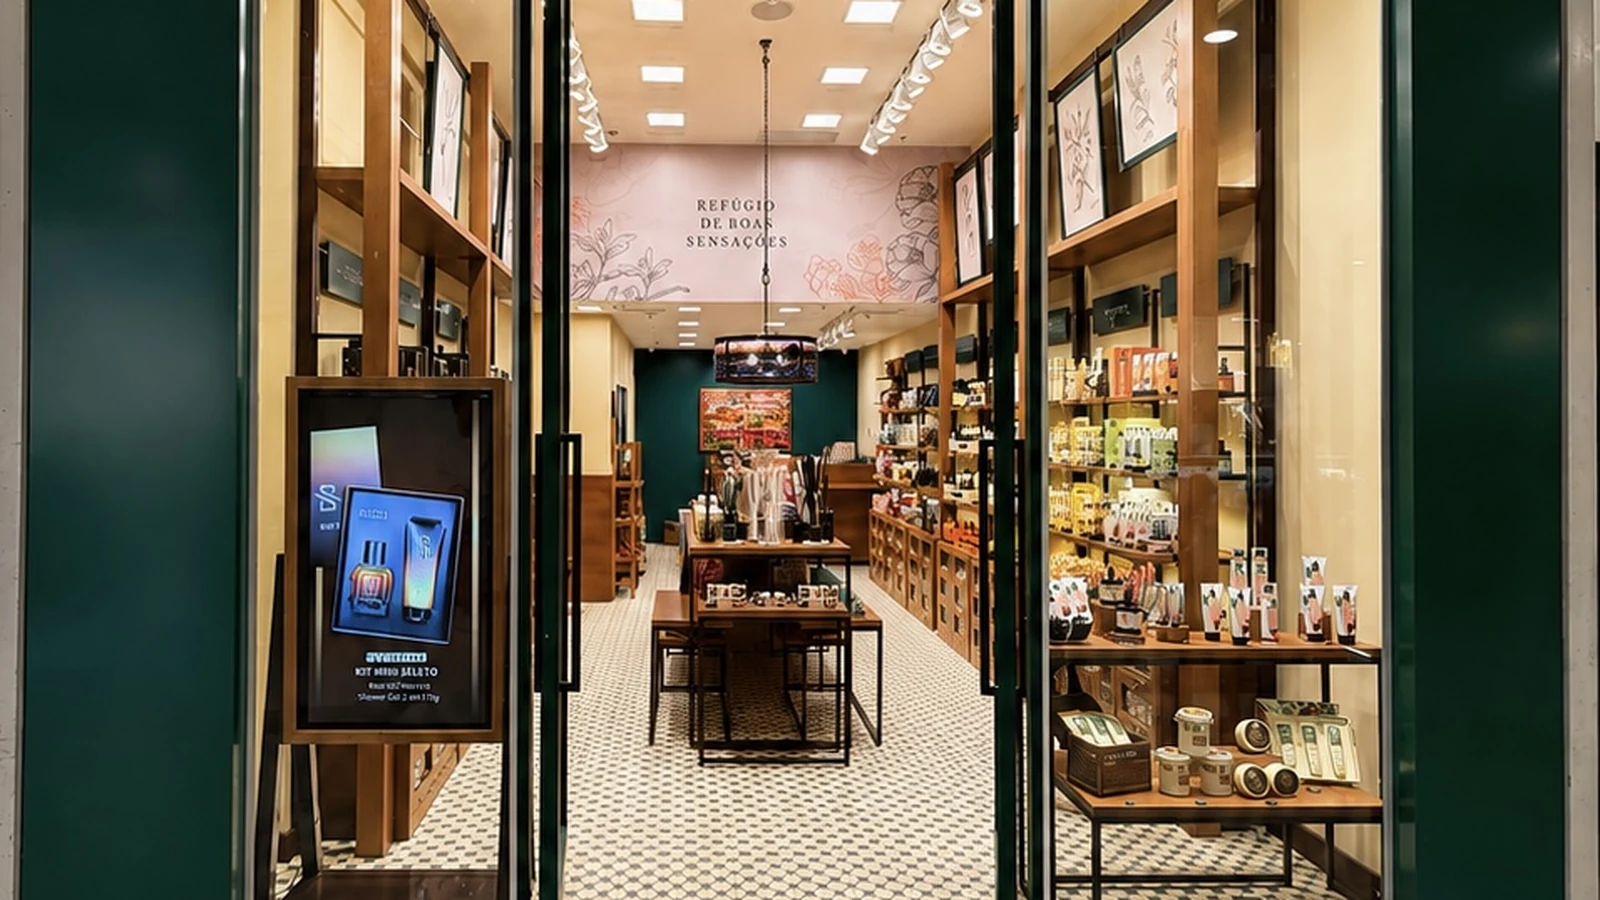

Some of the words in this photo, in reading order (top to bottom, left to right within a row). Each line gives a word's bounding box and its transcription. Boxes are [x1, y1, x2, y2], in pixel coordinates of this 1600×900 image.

[697, 197, 776, 212] REFÚGIO
[700, 217, 722, 229] DE
[729, 217, 773, 229] BOAS
[686, 232, 788, 250] SENSAÇÕES
